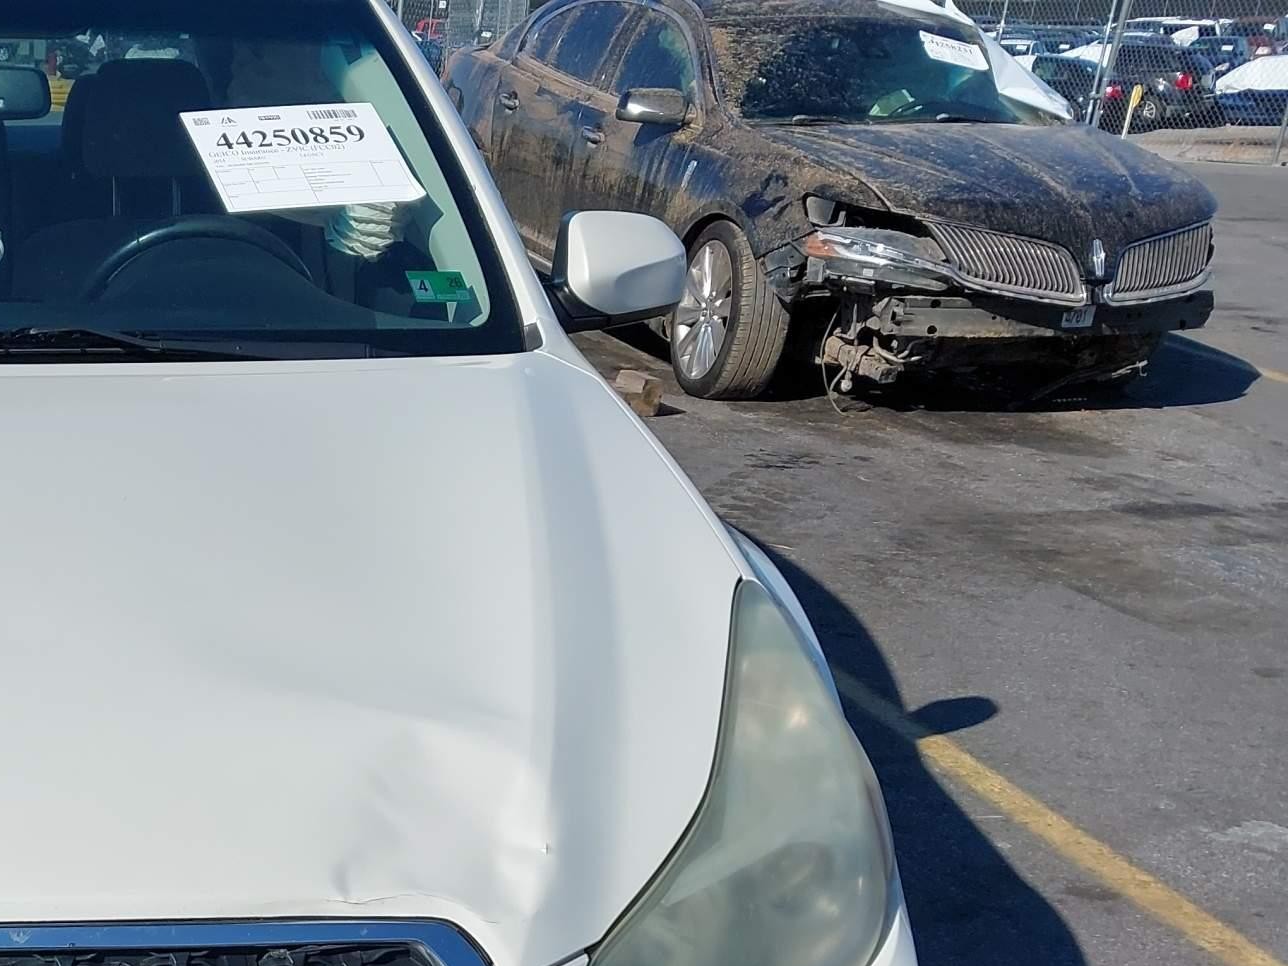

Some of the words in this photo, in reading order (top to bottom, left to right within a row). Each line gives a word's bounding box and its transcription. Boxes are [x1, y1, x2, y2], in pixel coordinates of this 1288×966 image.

[216, 124, 366, 150] 44250859
[208, 149, 239, 158] GEICO
[241, 147, 279, 156] Insurance
[416, 280, 428, 292] 4
